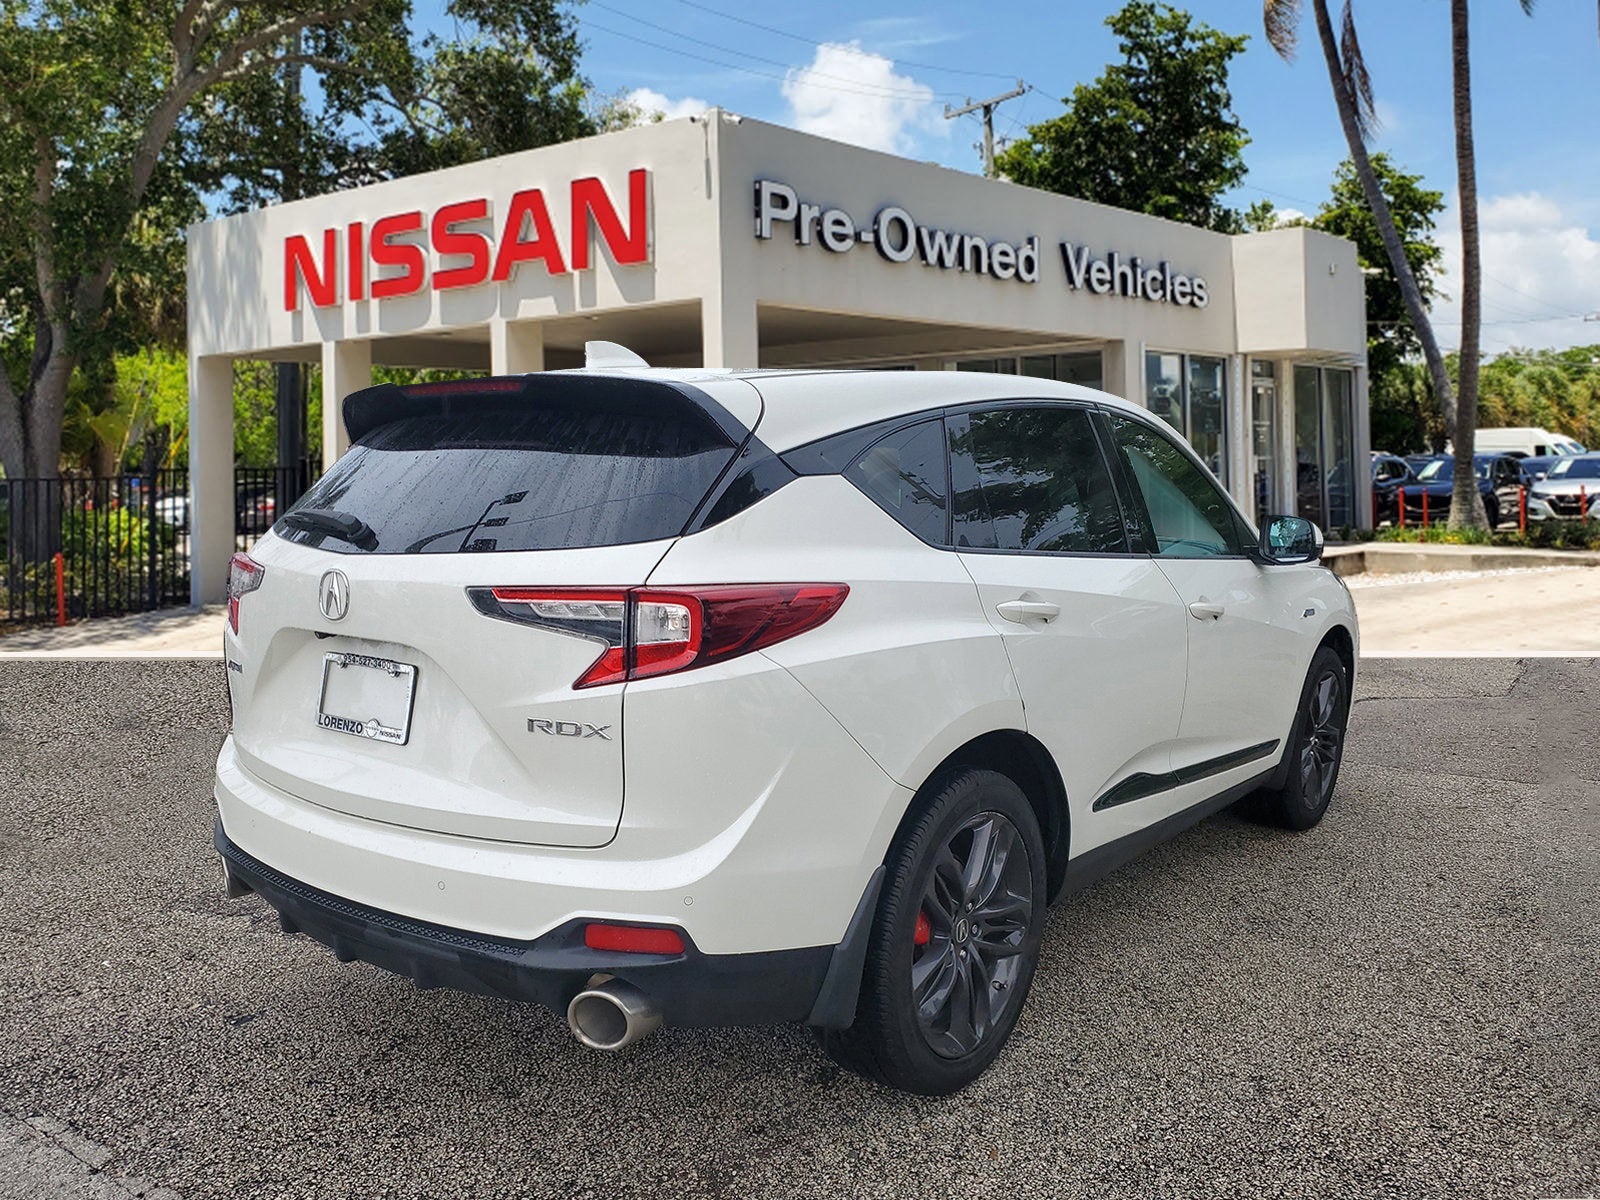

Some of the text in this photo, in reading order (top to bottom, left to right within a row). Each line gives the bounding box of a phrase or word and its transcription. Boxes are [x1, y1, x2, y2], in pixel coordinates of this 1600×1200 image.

[284, 168, 648, 312] NISSAN
[754, 179, 1209, 308] Pre-Owned Vehicles
[318, 714, 364, 734] LORENZO
[527, 716, 613, 741] RDX
